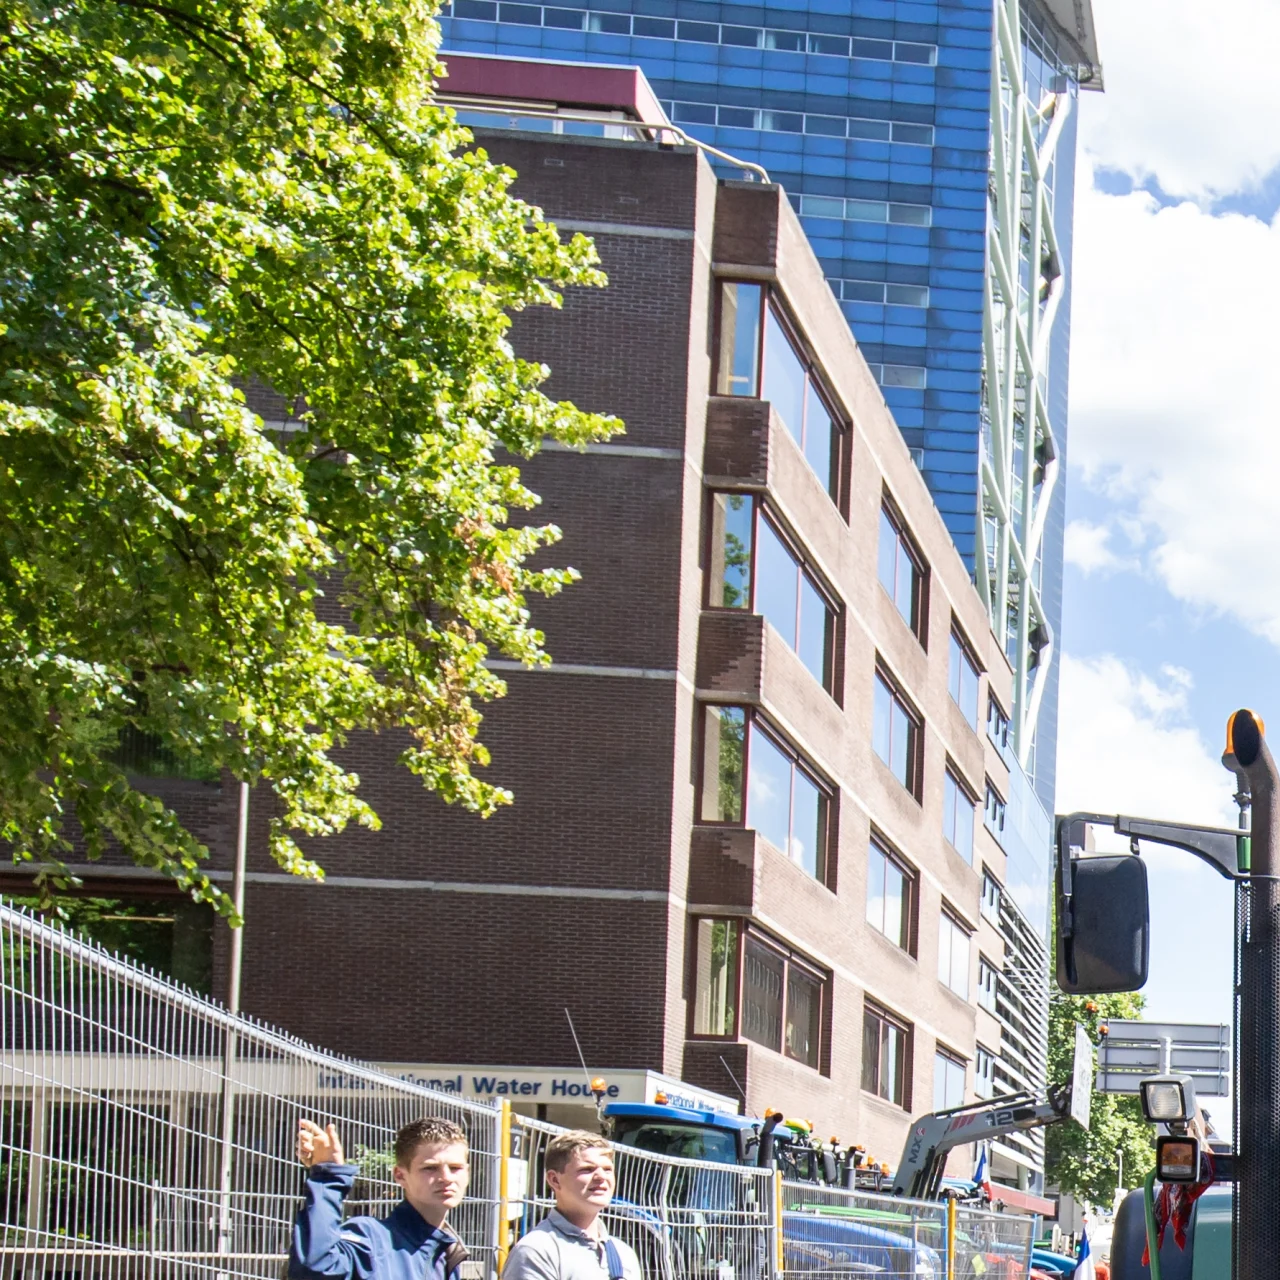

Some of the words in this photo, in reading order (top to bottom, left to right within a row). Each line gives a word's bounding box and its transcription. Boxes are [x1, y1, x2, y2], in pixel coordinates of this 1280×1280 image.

[473, 1077, 541, 1094] Water
[551, 1079, 619, 1098] Houe
[908, 1138, 923, 1164] MX
